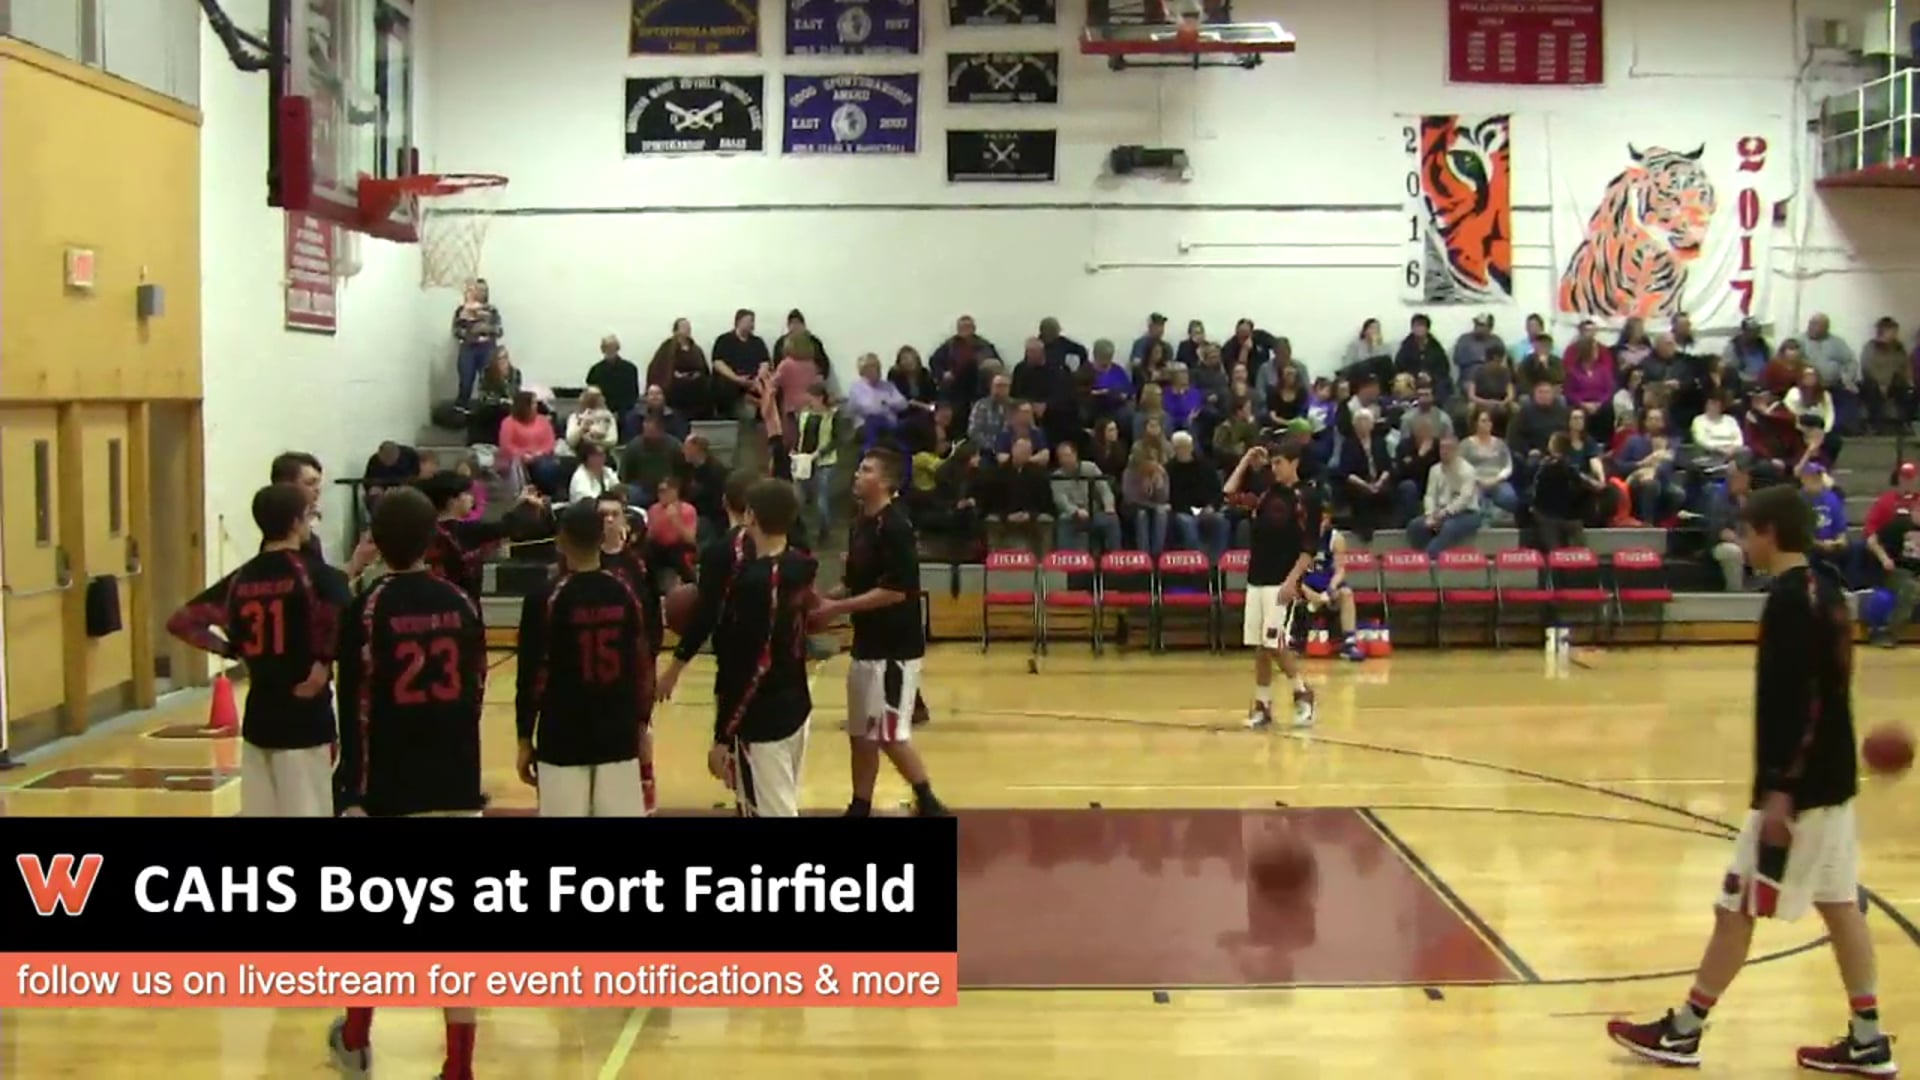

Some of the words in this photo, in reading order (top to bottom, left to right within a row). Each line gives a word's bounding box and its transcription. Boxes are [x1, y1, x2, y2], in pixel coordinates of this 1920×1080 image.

[791, 118, 819, 129] EAST
[1402, 126, 1420, 288] 2016
[1729, 135, 1768, 317] 2017
[239, 600, 286, 656] 31
[577, 628, 621, 684] 15
[393, 636, 462, 704] 23
